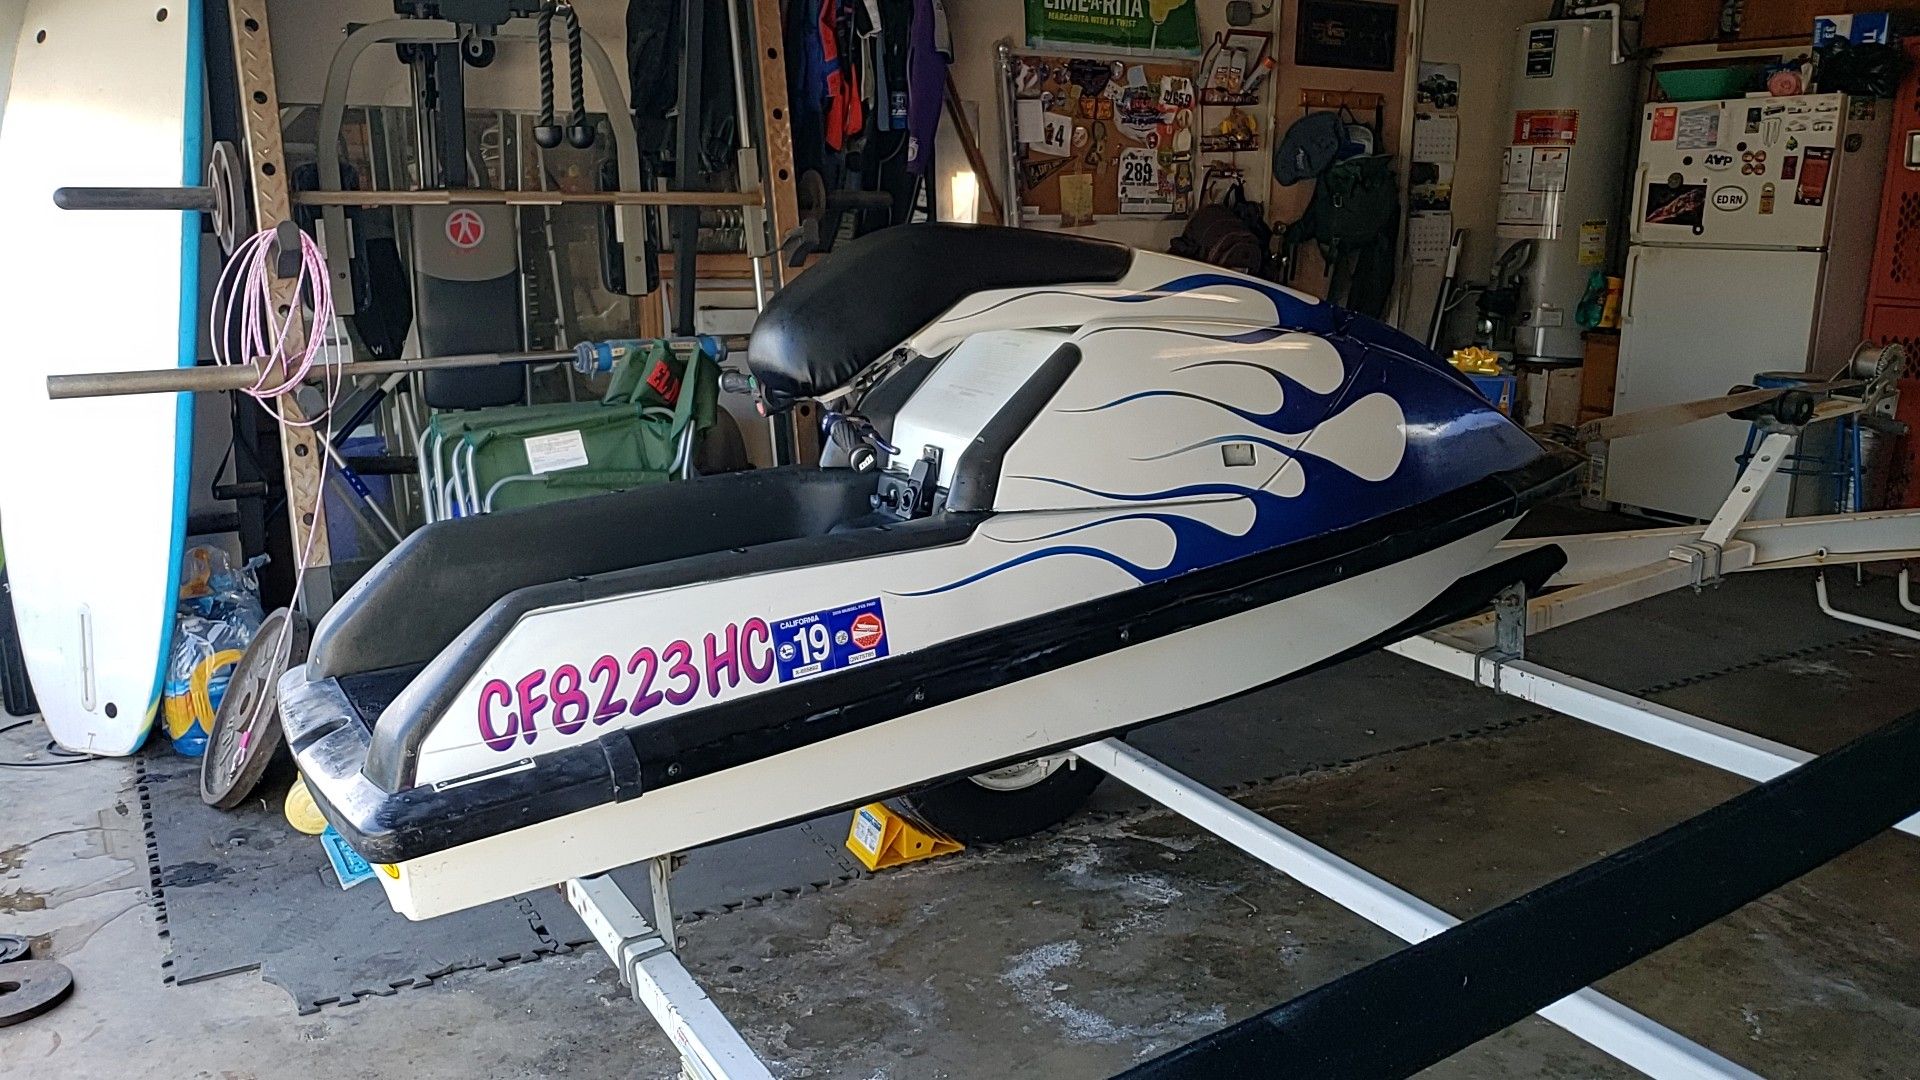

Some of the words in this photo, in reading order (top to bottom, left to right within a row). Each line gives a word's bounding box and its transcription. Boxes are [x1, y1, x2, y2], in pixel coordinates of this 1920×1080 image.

[1048, 11, 1089, 24] MARGARITA
[1090, 16, 1109, 26] WITH
[1109, 18, 1115, 26] A
[1116, 19, 1137, 28] TWIST
[1125, 162, 1152, 182] 289
[1716, 195, 1729, 204] ED
[1729, 195, 1743, 204] RN
[780, 615, 820, 630] CALIFORNIA
[793, 623, 831, 664] 19
